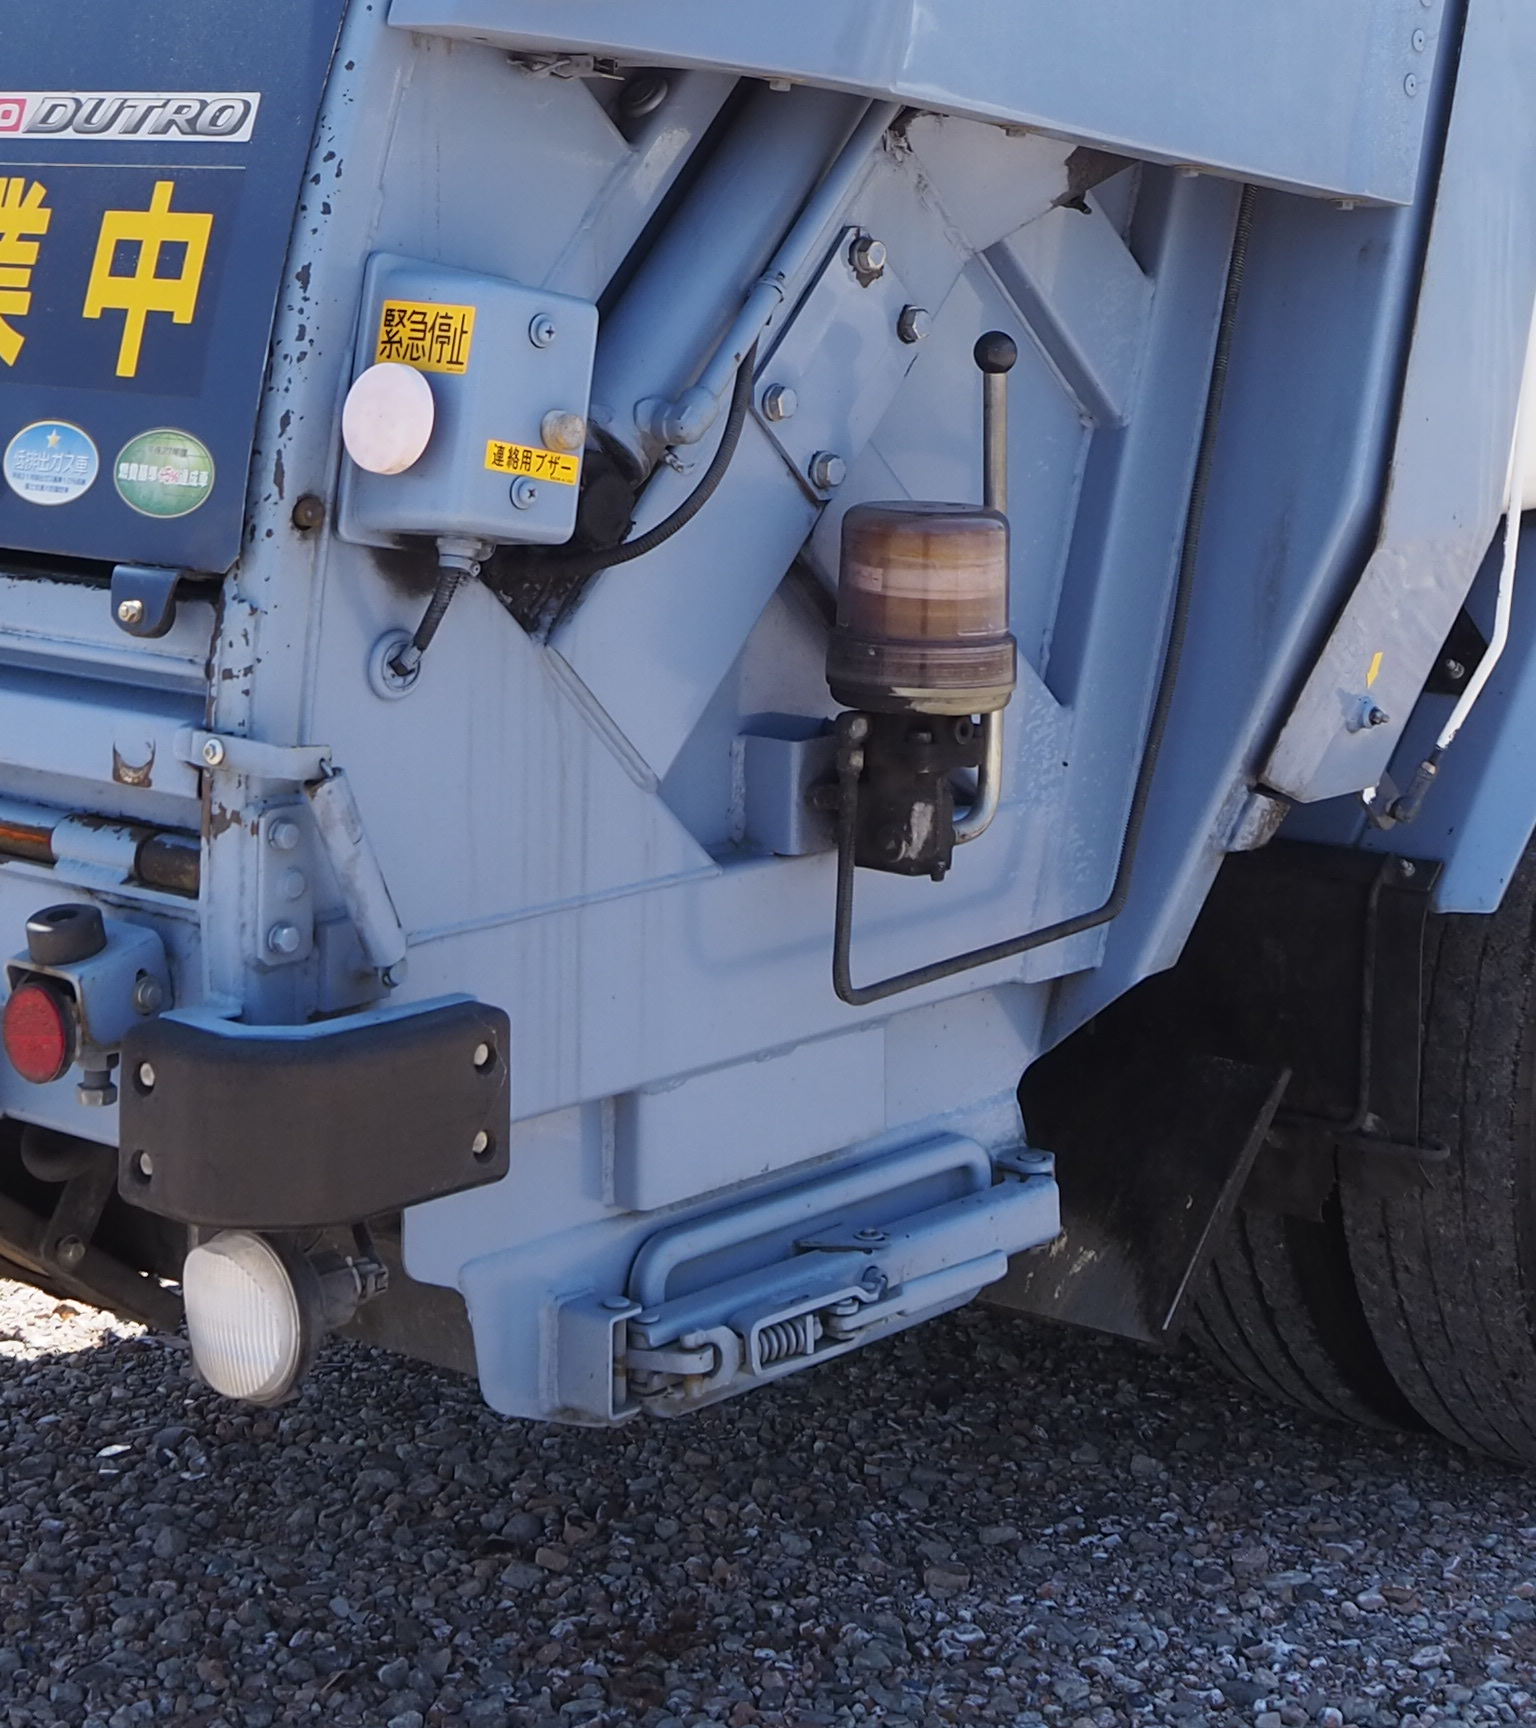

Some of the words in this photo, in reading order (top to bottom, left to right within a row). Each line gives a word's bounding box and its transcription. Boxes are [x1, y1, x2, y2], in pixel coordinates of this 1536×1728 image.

[22, 96, 251, 136] DUTRO
[379, 308, 469, 366] 緊急停止
[492, 443, 571, 476] 連絡用ブザー
